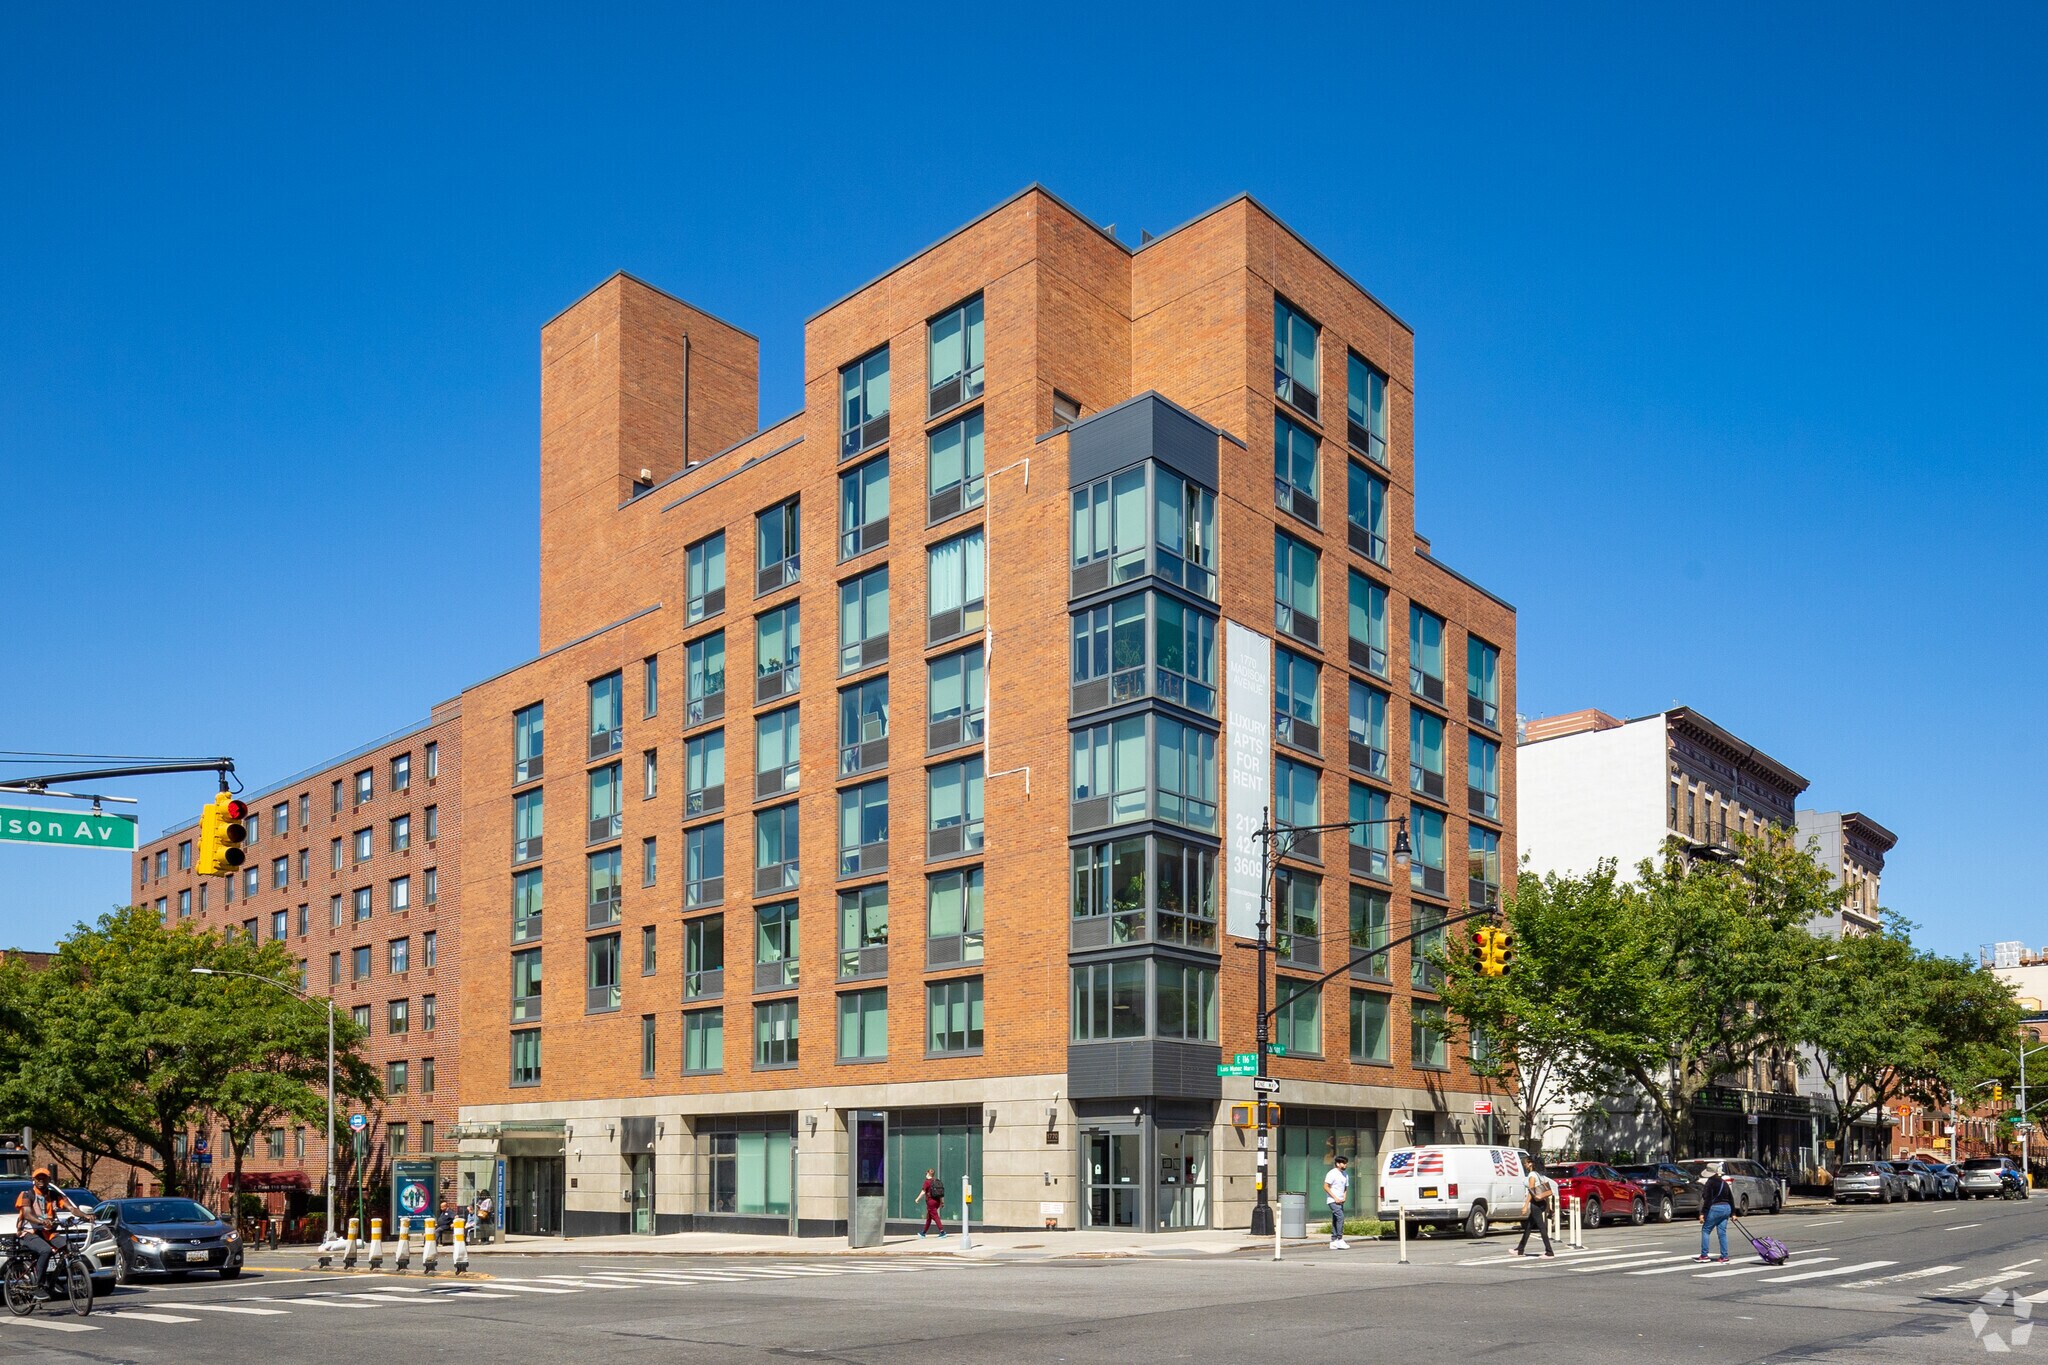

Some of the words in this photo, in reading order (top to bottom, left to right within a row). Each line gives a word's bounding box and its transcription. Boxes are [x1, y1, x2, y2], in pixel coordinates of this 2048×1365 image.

[1230, 660, 1266, 685] MADISON
[1233, 674, 1264, 696] AVENUE
[1229, 710, 1267, 737] LUXURY
[1233, 731, 1264, 755] APTS
[1236, 750, 1260, 773] FOR
[1232, 768, 1264, 792] RENT
[74, 821, 113, 840] Av
[1234, 856, 1262, 879] 3609
[1242, 1055, 1250, 1064] 116
